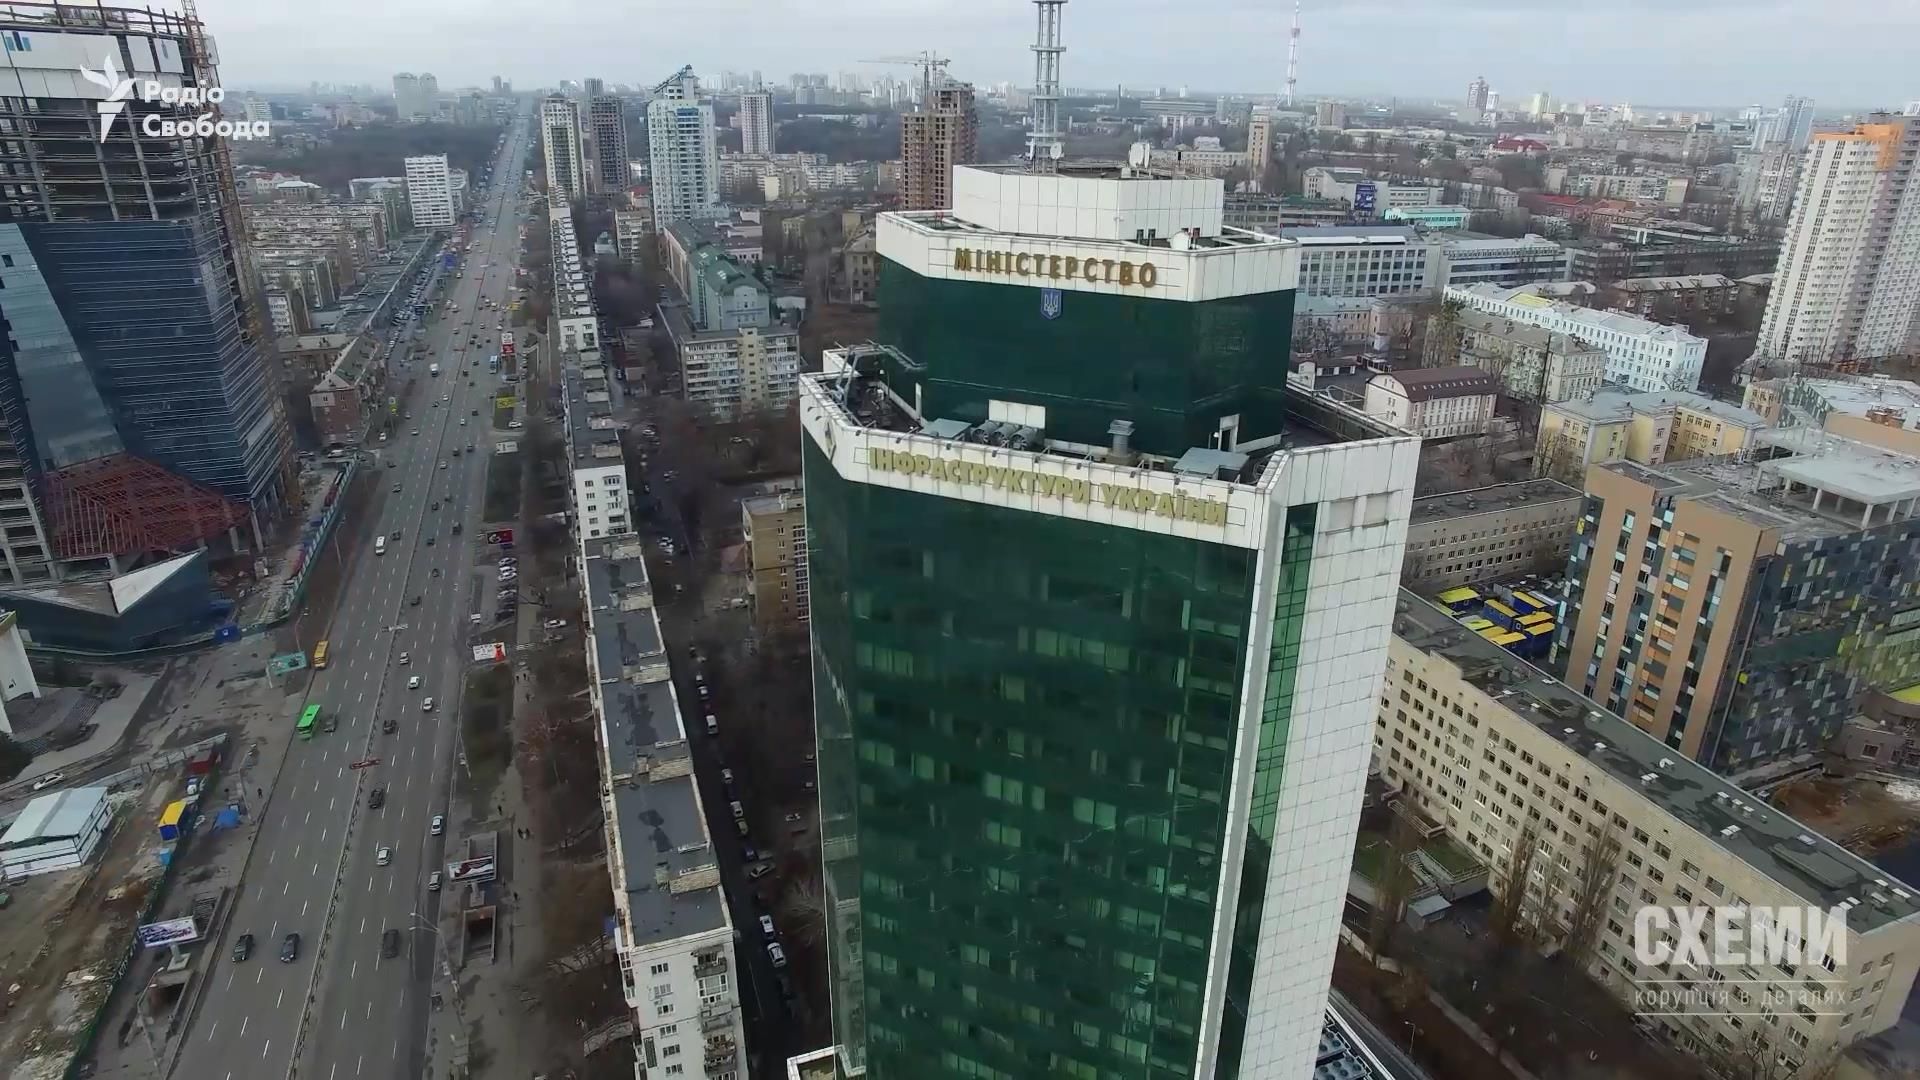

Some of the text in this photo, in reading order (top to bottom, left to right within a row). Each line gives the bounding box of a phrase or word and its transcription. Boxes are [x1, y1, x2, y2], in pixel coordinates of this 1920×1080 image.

[954, 247, 1157, 288] МІНІСТЕРСТВО
[868, 447, 1227, 527] ІНФРАСТРУКТУРИ УКРАЇНИ
